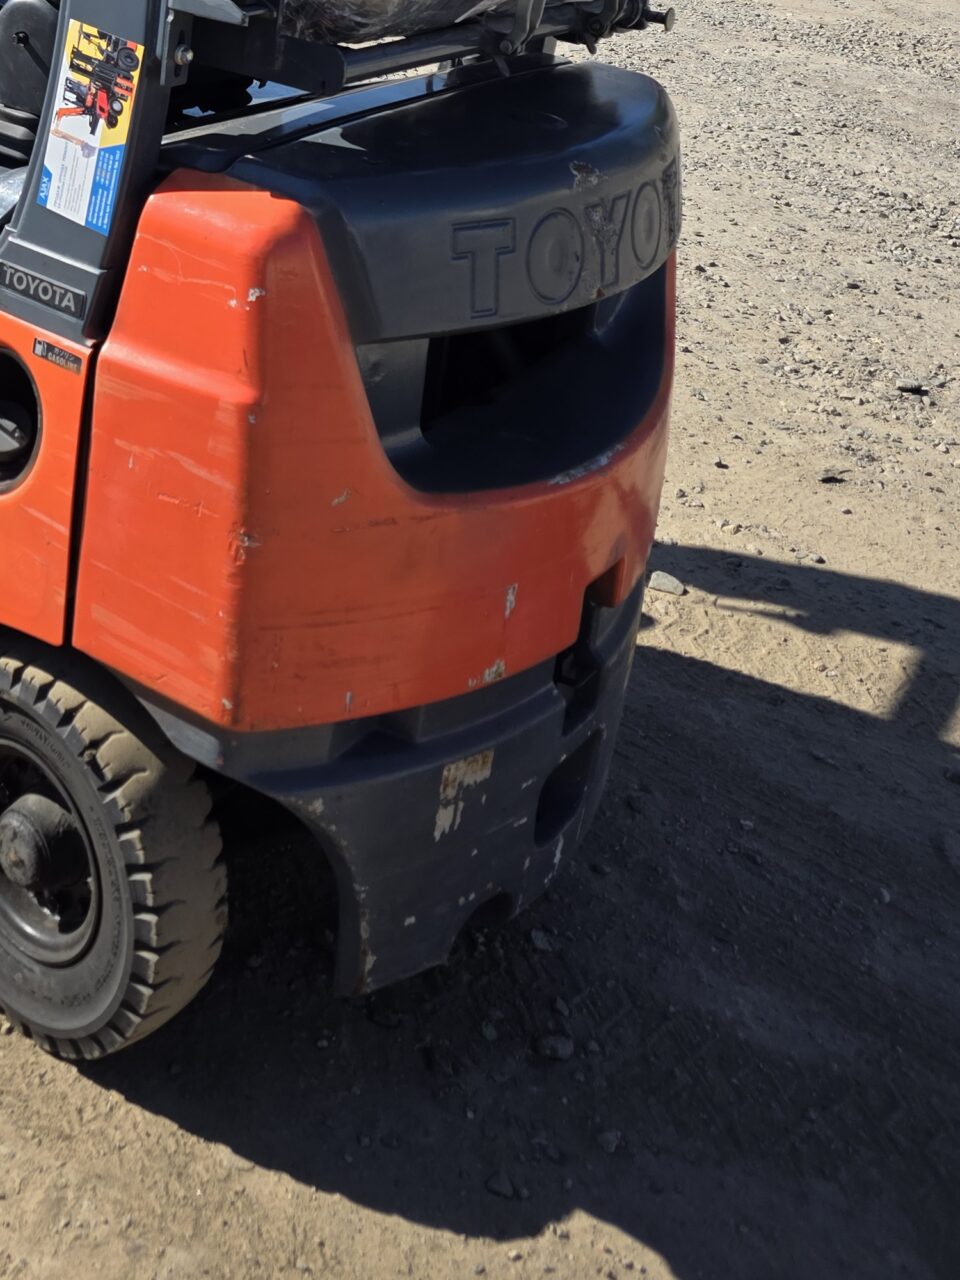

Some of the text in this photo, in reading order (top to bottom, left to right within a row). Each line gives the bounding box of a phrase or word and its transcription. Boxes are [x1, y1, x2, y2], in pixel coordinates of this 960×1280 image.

[40, 176, 49, 201] AJAX
[3, 265, 76, 312] TOYOTA
[47, 351, 81, 373] GASOLINE
